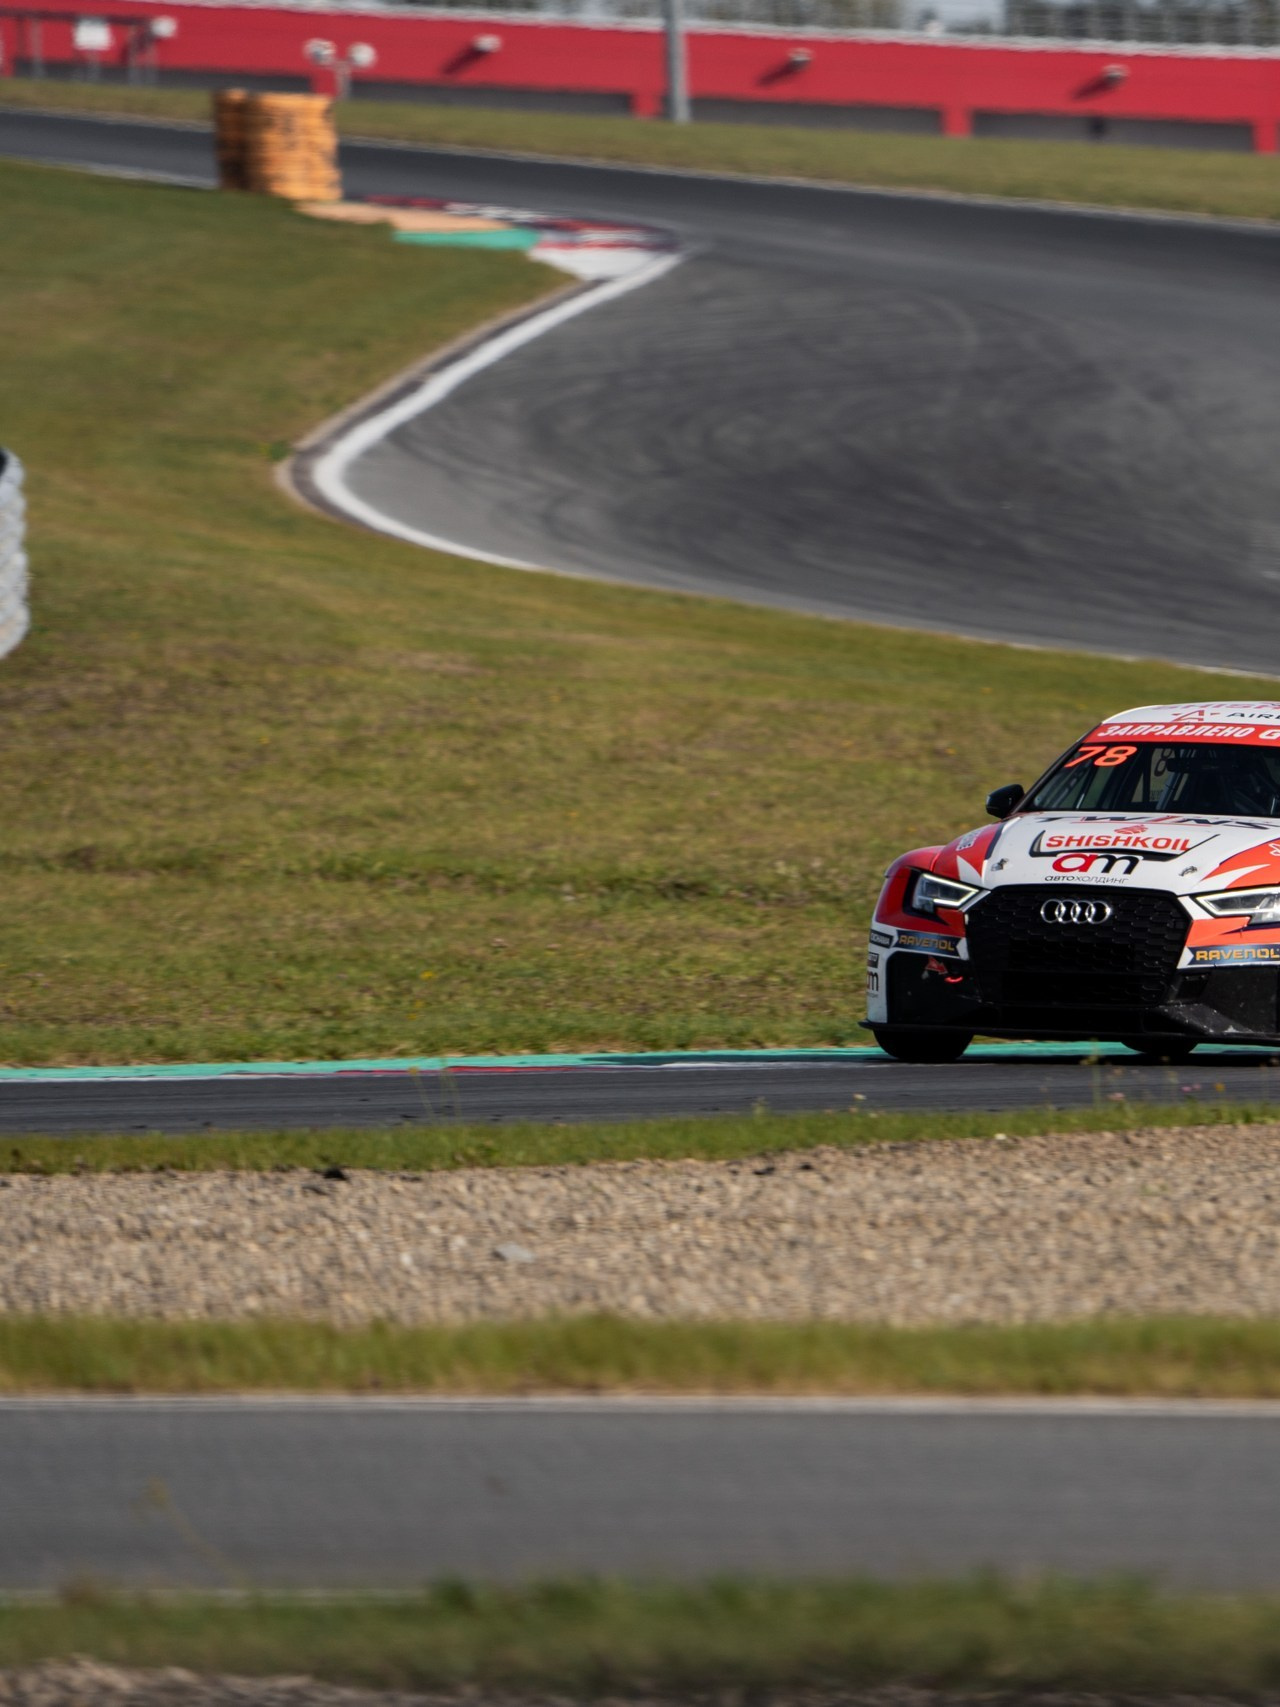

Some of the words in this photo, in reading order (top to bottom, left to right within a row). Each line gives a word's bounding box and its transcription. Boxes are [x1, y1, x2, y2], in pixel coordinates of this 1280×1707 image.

[1097, 724, 1256, 739] ЗАПРАВЛЕНО
[1065, 746, 1138, 768] 78
[1046, 835, 1191, 851] SHISHKOIL
[899, 935, 955, 951] RAVENOL
[1196, 949, 1280, 961] RAVENOL
